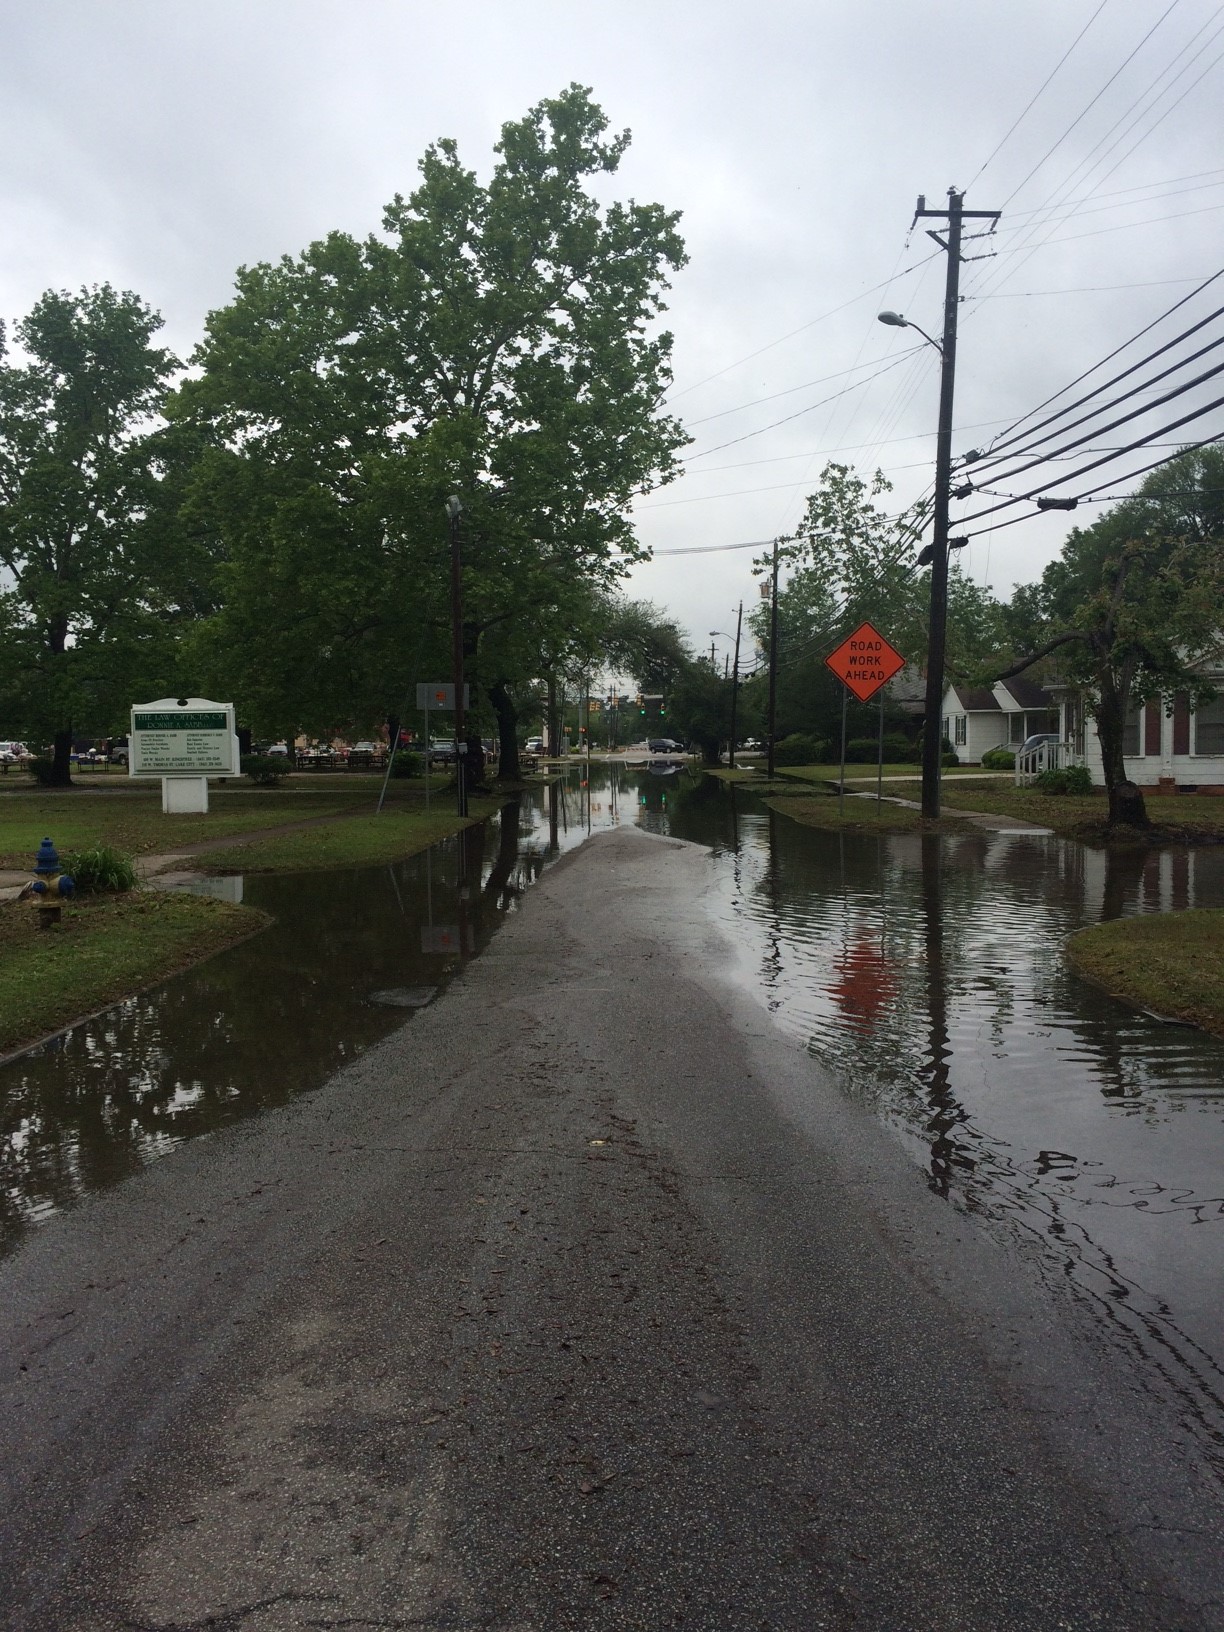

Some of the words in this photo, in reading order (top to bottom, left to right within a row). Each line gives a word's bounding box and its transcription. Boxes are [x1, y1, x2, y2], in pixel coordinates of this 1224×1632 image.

[850, 641, 882, 651] ROAD
[849, 656, 882, 666] WORK
[845, 670, 885, 680] AHEAD
